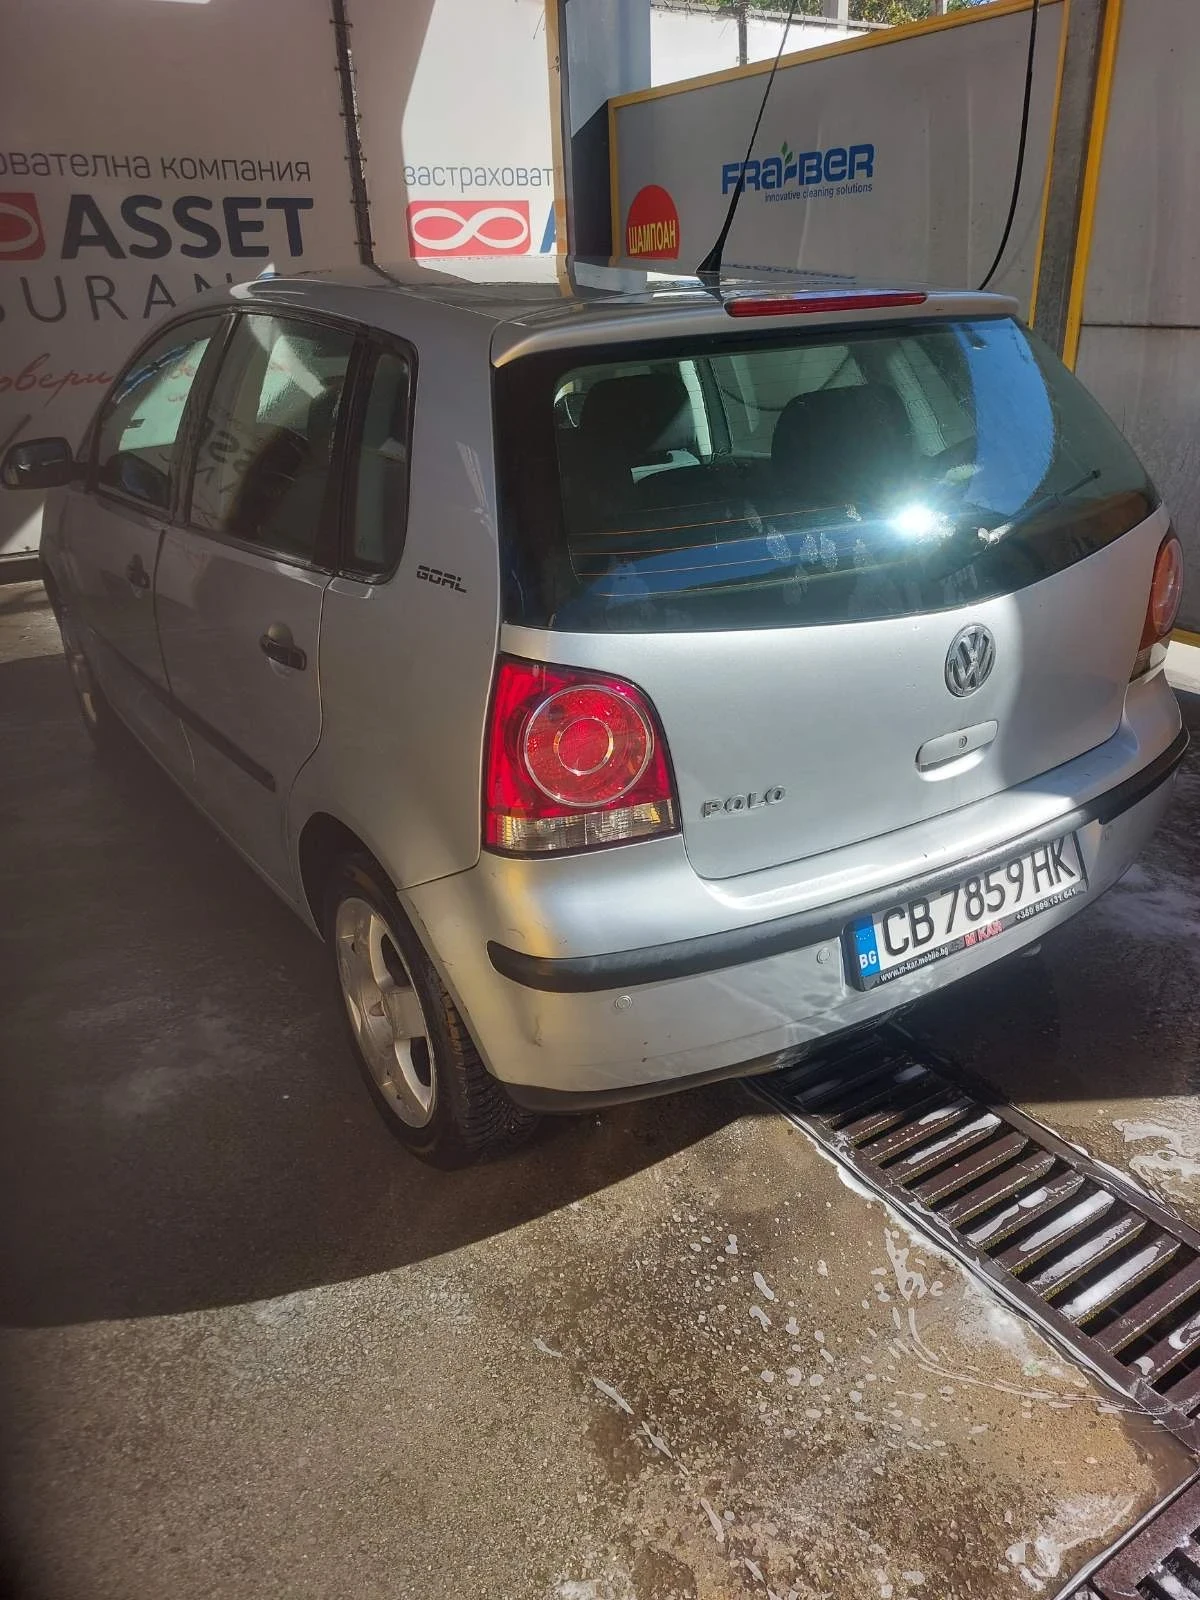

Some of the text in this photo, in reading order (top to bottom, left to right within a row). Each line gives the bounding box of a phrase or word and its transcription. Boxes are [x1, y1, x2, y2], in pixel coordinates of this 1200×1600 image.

[161, 157, 312, 182] компания
[764, 181, 873, 202] innovative cleaning solutions
[60, 194, 314, 260] ASSET
[628, 219, 676, 255] ШАМПОАН
[702, 785, 786, 818] POLO
[882, 836, 1077, 957] CB 7859 HK
[858, 948, 878, 970] BG
